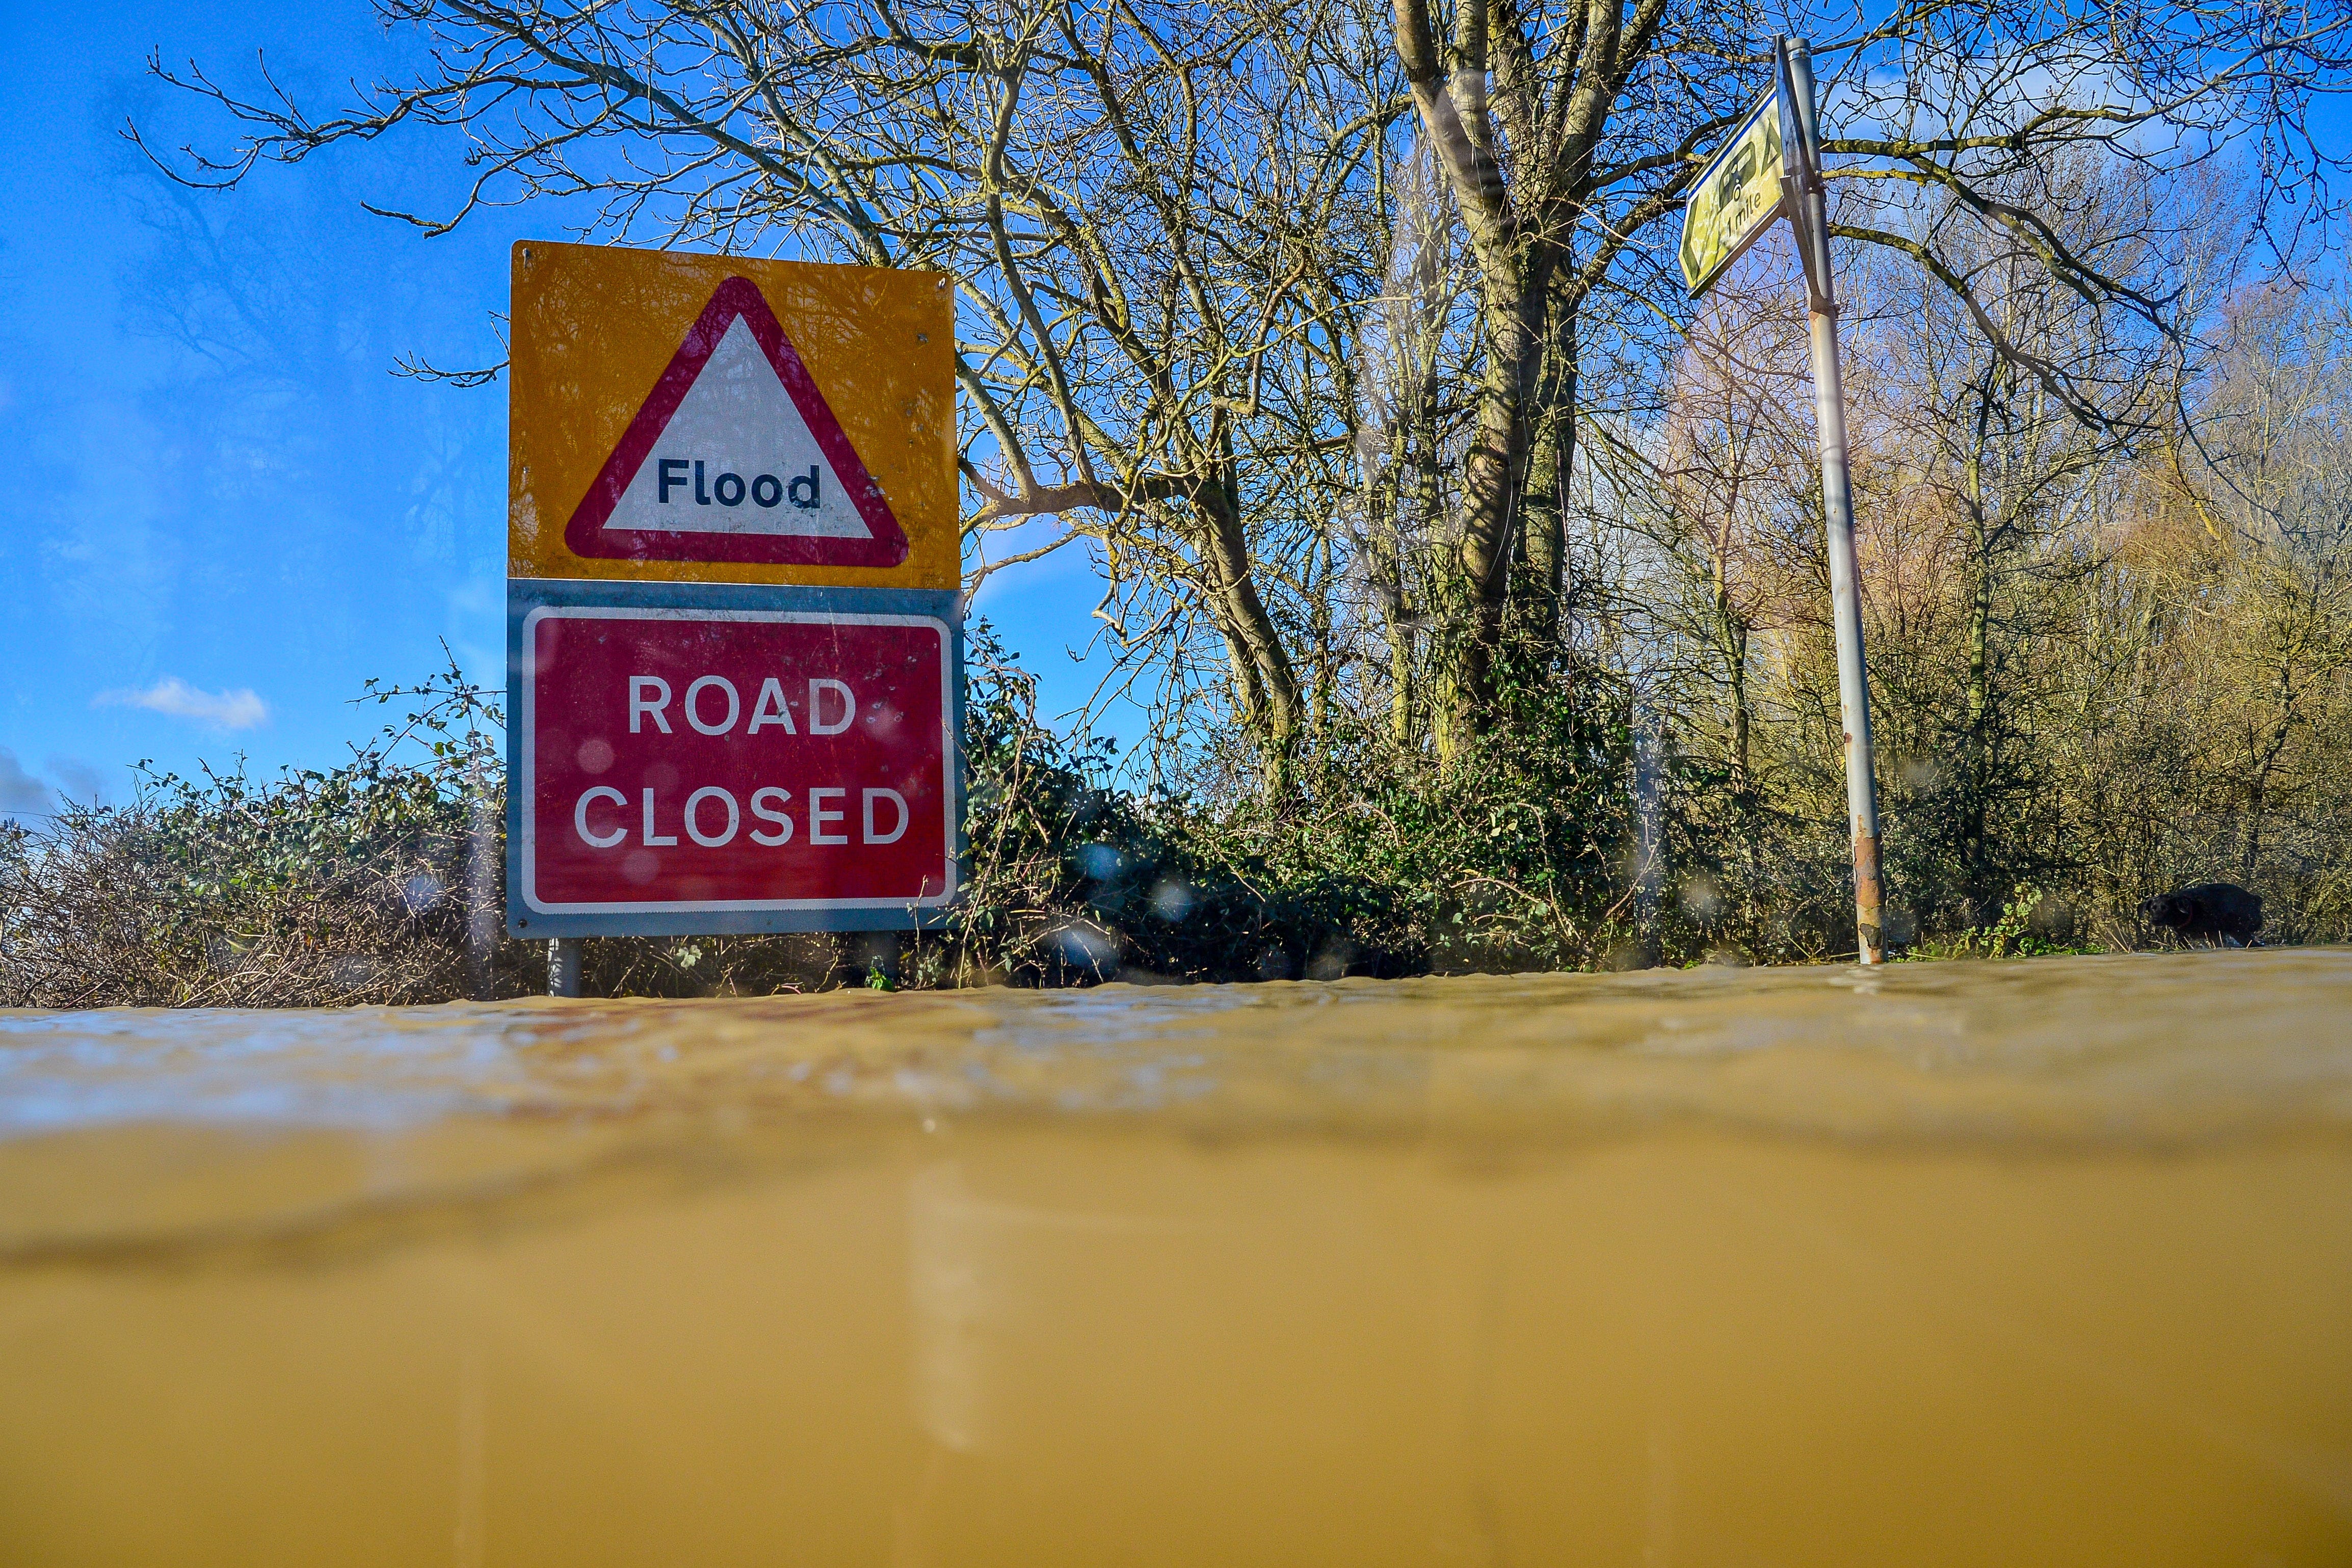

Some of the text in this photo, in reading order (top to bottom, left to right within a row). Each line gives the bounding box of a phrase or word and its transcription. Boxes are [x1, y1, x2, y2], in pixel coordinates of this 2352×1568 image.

[1727, 192, 1761, 237] 1 mile
[657, 458, 821, 509] Flood
[628, 675, 856, 736] ROAD
[574, 785, 909, 848] CLOSED
